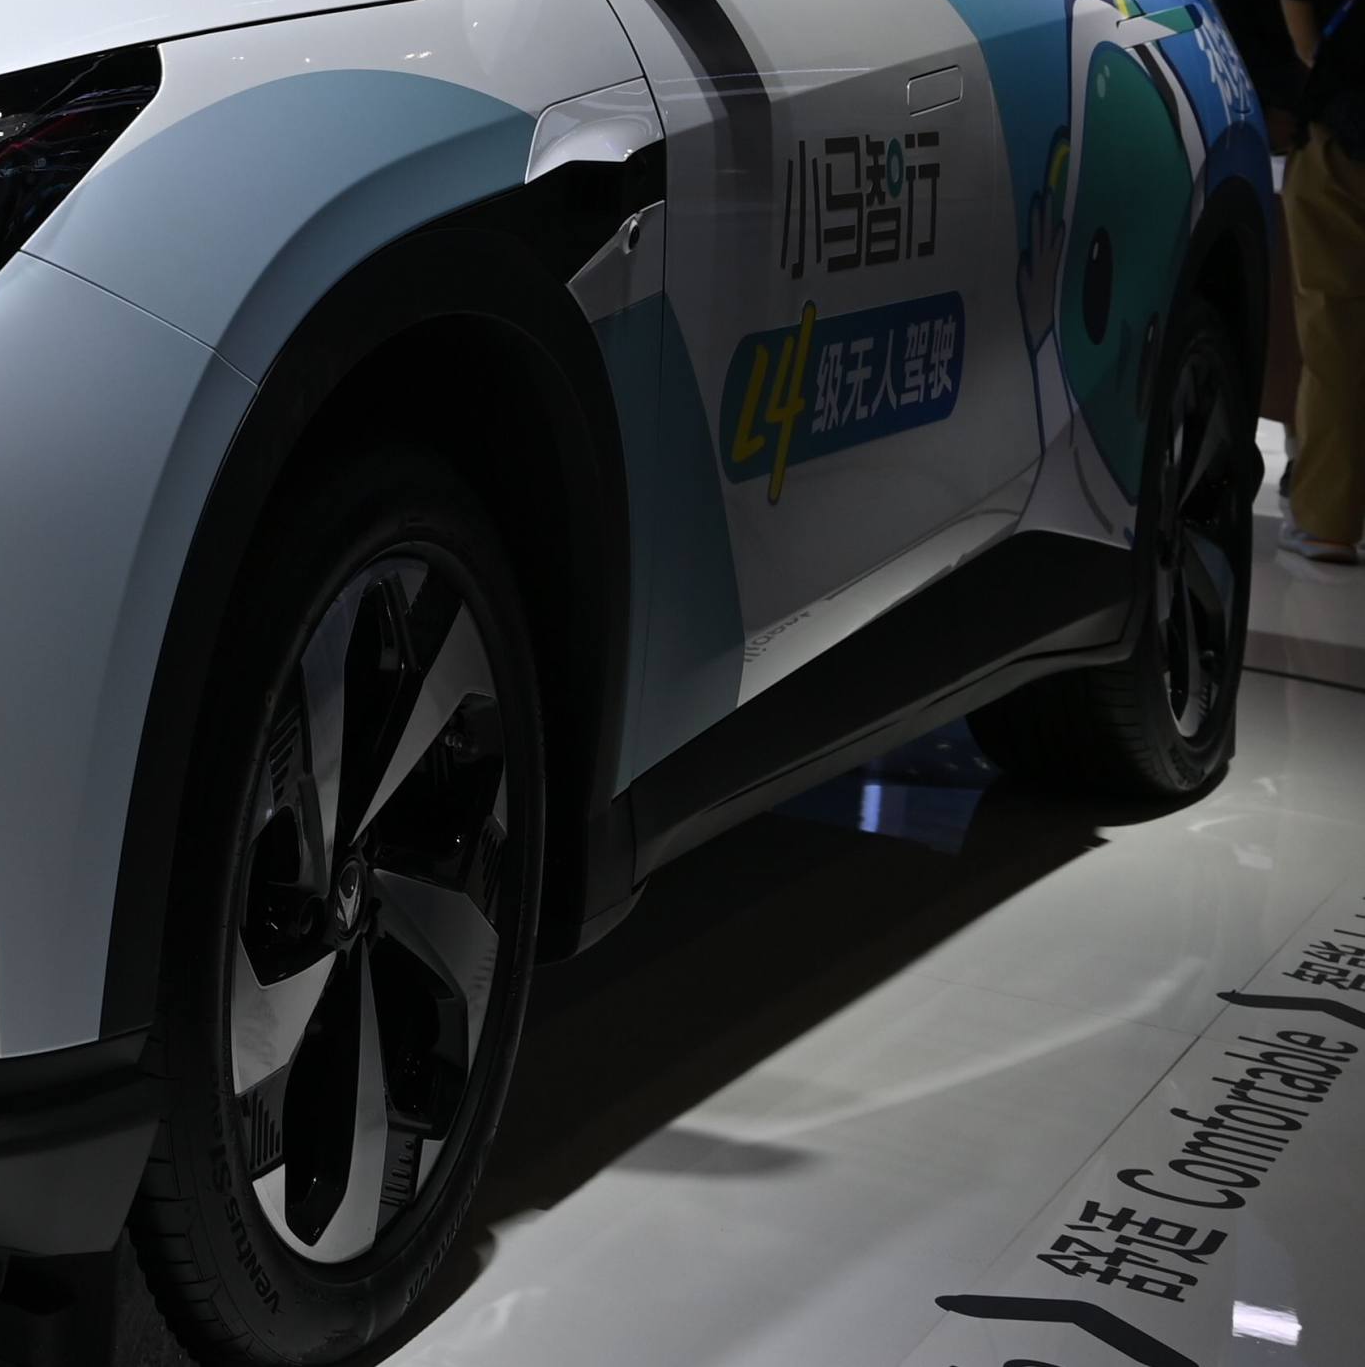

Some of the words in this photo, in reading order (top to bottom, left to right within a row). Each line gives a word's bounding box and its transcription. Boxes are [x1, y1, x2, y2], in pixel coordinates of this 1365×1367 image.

[780, 131, 941, 279] 小马智行
[1116, 1030, 1359, 1210] Comfortable
[1036, 1200, 1229, 1302] 舒适
